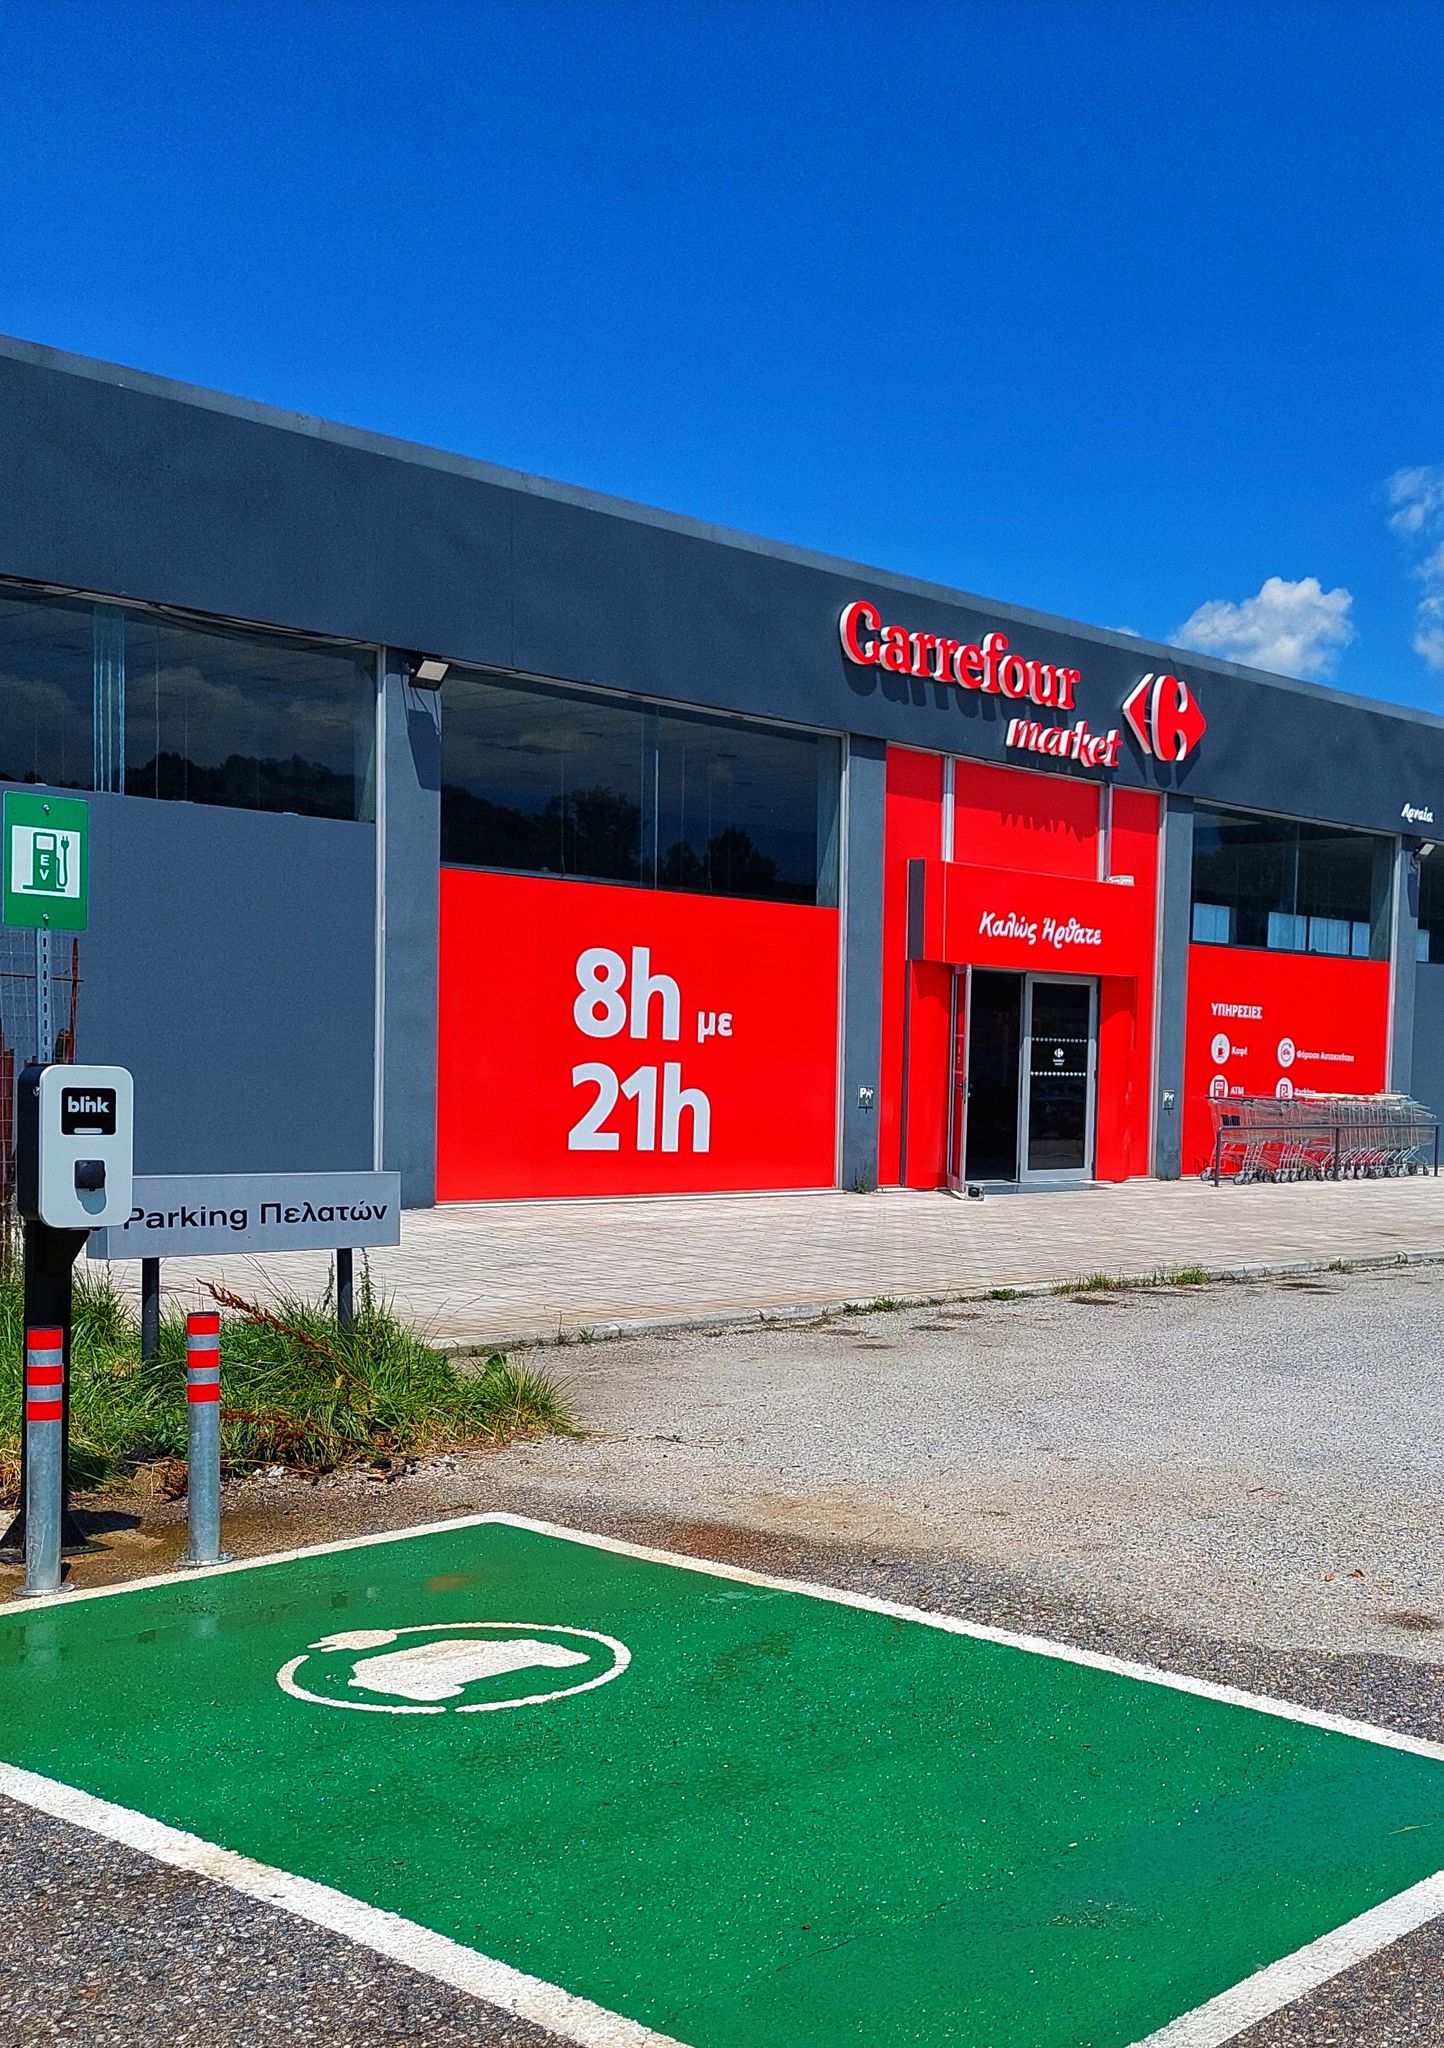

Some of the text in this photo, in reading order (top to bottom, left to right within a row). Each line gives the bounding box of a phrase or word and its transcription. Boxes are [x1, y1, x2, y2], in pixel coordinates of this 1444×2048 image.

[839, 600, 1081, 710] Carrefour
[1005, 718, 1123, 767] market
[573, 946, 733, 1043] 8h με
[1211, 1002, 1263, 1020] ΥΠΗΡΕΣΙΕΣ
[67, 1096, 110, 1113] blink
[568, 1062, 711, 1153] 21h
[1230, 1086, 1245, 1095] ATM
[123, 1200, 388, 1230] Parking Πελατών
